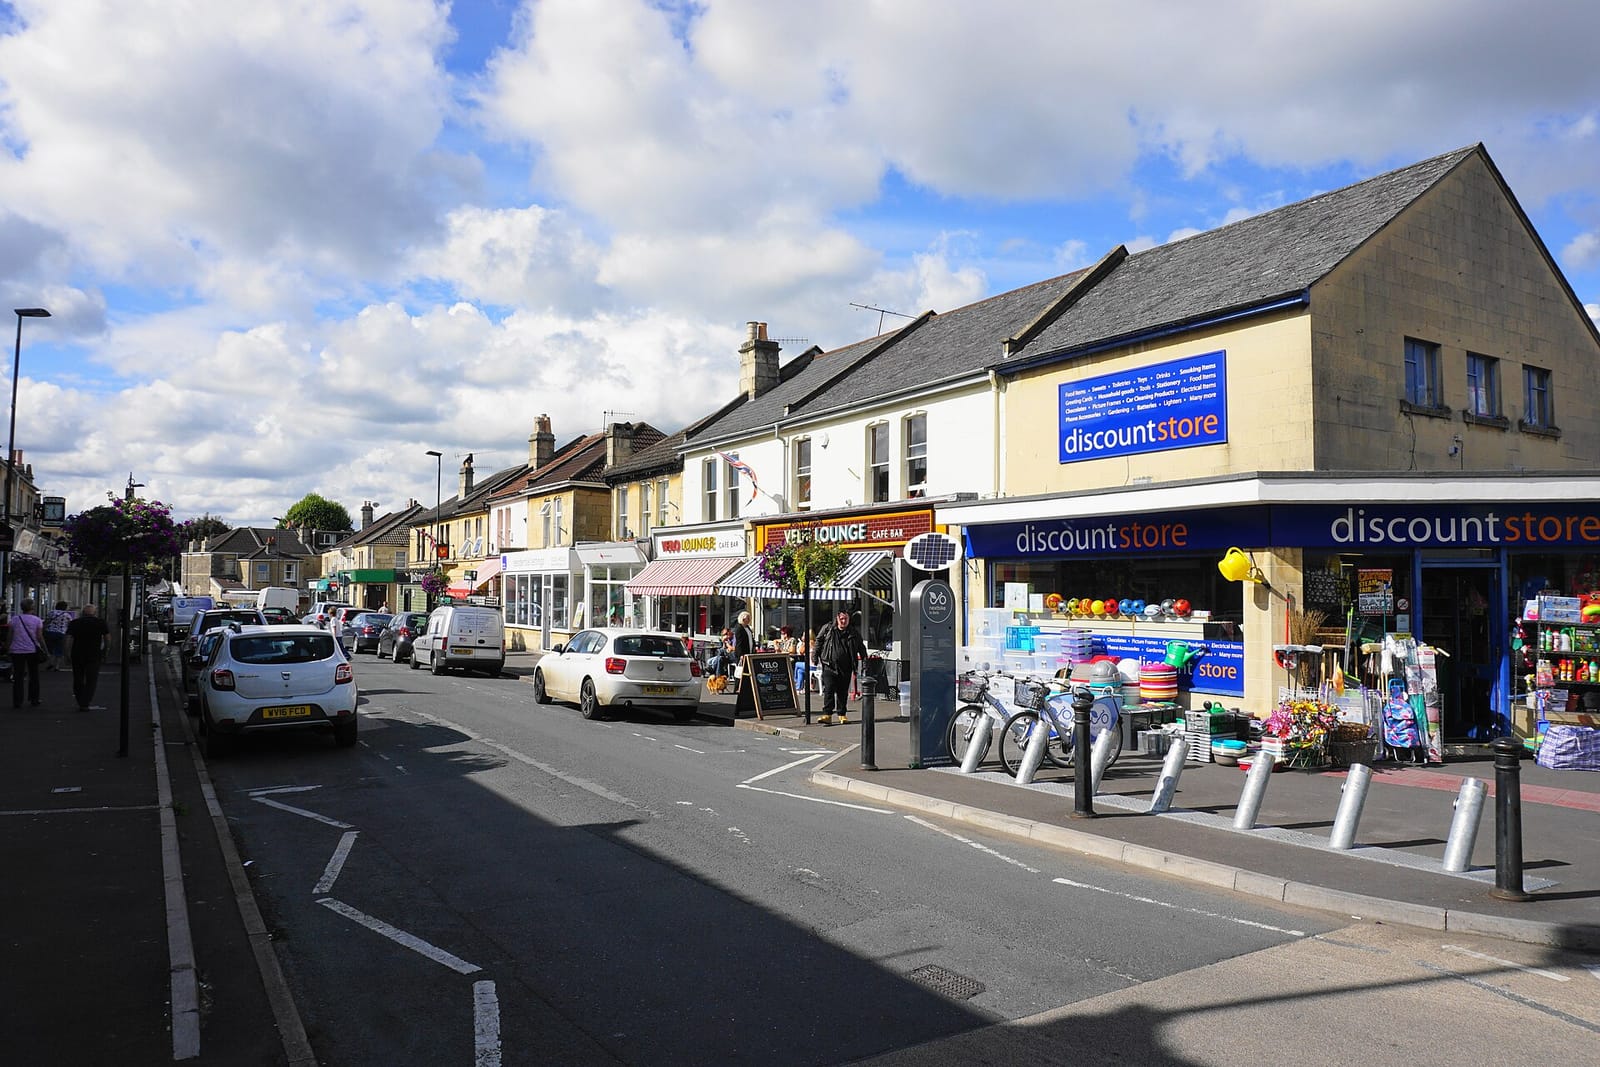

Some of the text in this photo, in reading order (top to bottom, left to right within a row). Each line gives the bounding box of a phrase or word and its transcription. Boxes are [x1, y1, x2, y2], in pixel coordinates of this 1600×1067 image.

[1112, 380, 1131, 388] Toiletries
[1179, 366, 1201, 375] Smoking
[1201, 363, 1216, 371] Items
[1097, 390, 1120, 399] Household
[1120, 387, 1135, 396] goods
[1156, 380, 1181, 388] Stationery
[1189, 374, 1201, 382] Food
[1065, 406, 1087, 414] Chocolates
[1133, 394, 1153, 402] Cleaning
[1154, 390, 1175, 398] Products
[1181, 384, 1202, 393] Electrical
[1108, 407, 1130, 415] Gardening
[1163, 398, 1182, 406] Lighters
[814, 523, 867, 543] LOUNGE
[890, 528, 904, 538] BAR
[661, 539, 681, 553] VELO
[681, 536, 717, 552] LOUNGE
[730, 540, 739, 548] BAR
[760, 661, 778, 669] VELO
[1199, 662, 1237, 679] store
[290, 706, 306, 716] FCD
